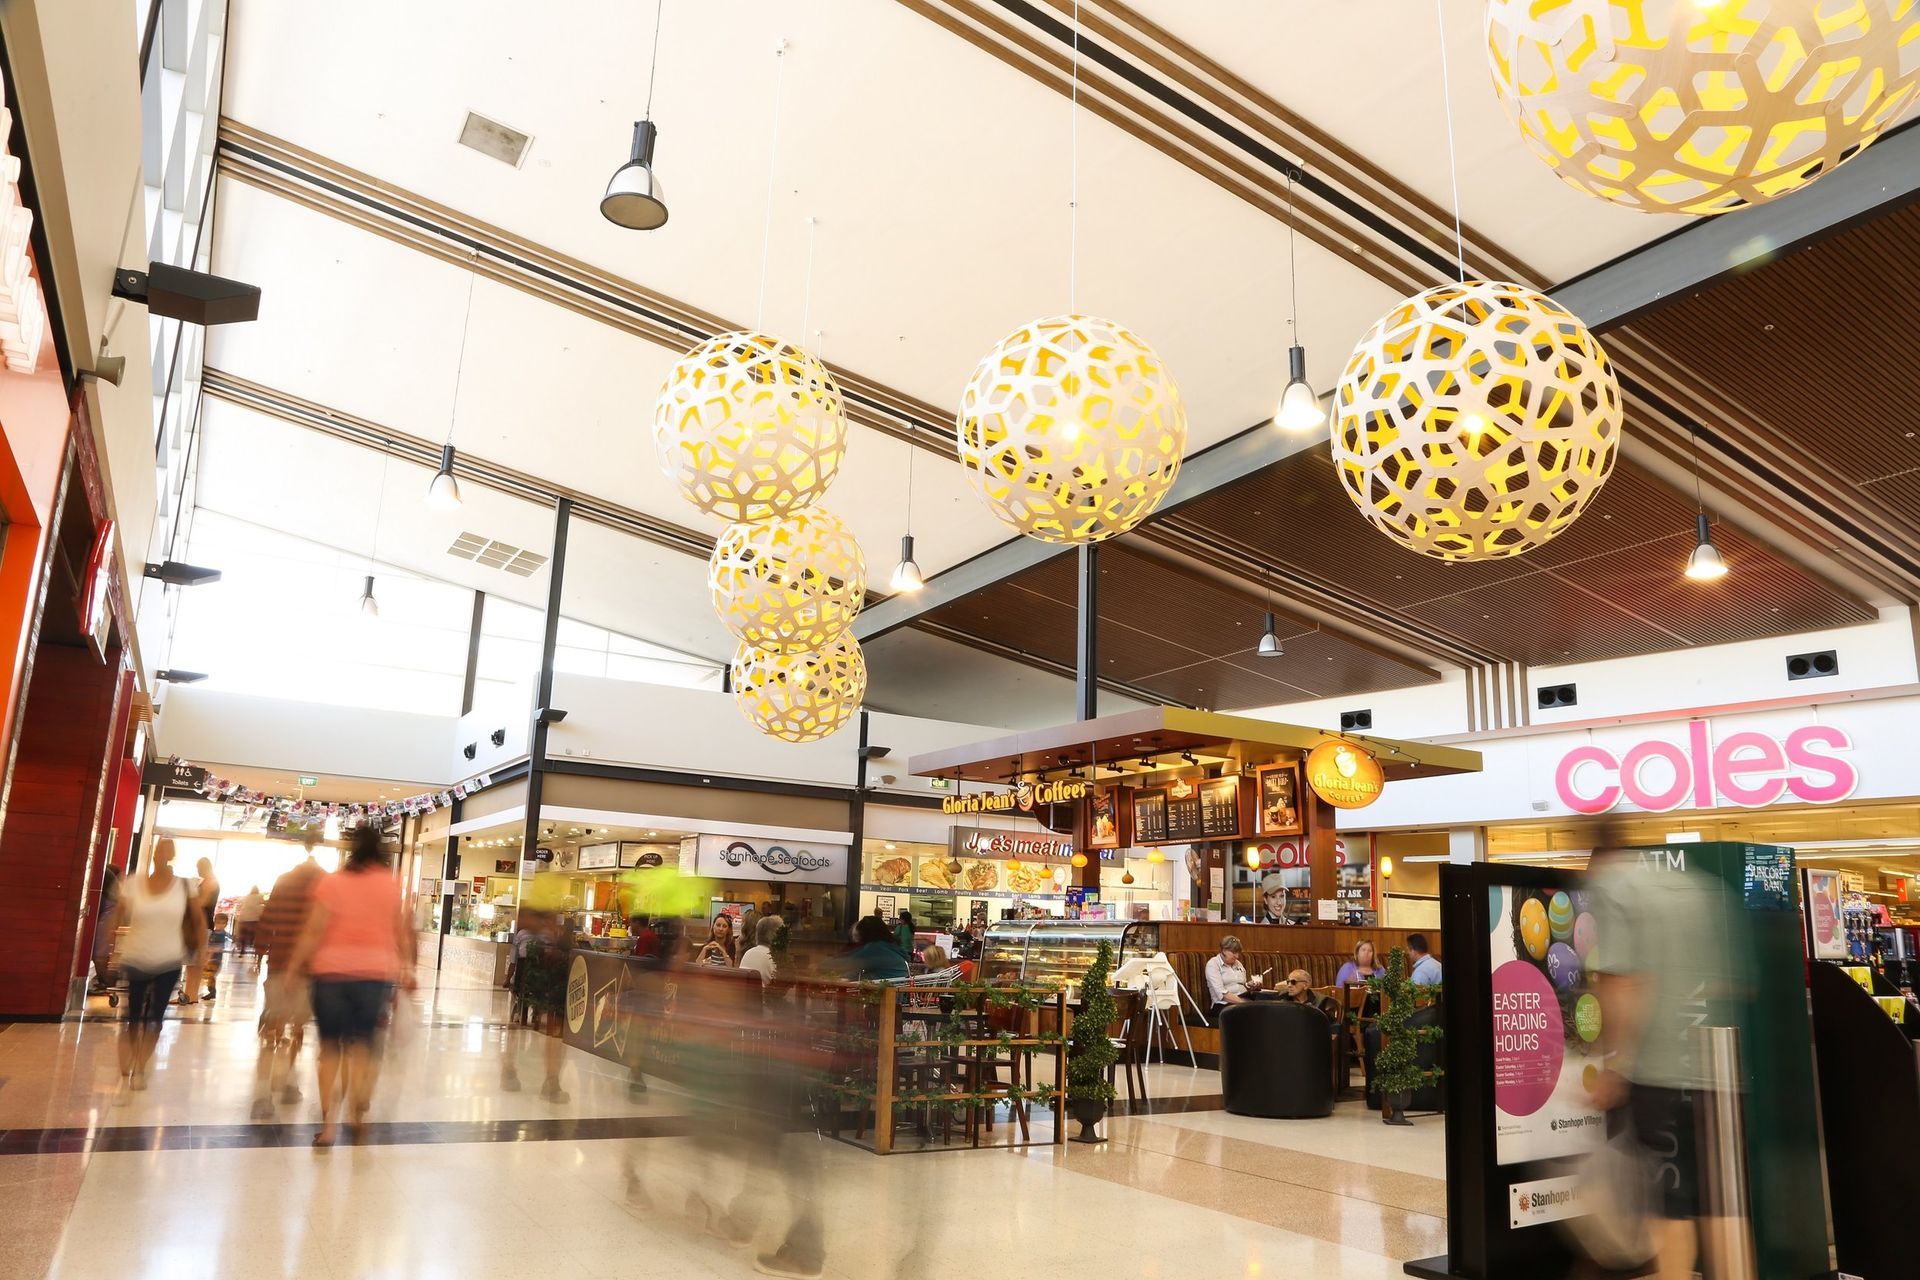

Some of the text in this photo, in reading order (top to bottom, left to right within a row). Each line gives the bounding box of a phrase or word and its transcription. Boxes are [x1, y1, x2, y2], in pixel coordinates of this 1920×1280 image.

[1555, 719, 1859, 815] coles
[172, 778, 189, 786] Toilets
[1314, 773, 1379, 793] Gloria Jean's
[943, 793, 978, 814] Gloria
[980, 789, 1015, 811] Jean's
[1015, 840, 1059, 856] meat
[1258, 836, 1346, 869] cols
[719, 850, 830, 868] Stanhope Seafoods
[1637, 849, 1685, 872] ATM
[1347, 889, 1362, 898] ASK
[1494, 993, 1541, 1011] EASTER
[1494, 1013, 1547, 1031] TRADING
[1495, 1034, 1539, 1052] HOURS
[1558, 1117, 1583, 1129] Stanhope
[1531, 1189, 1570, 1208] Stanhope
